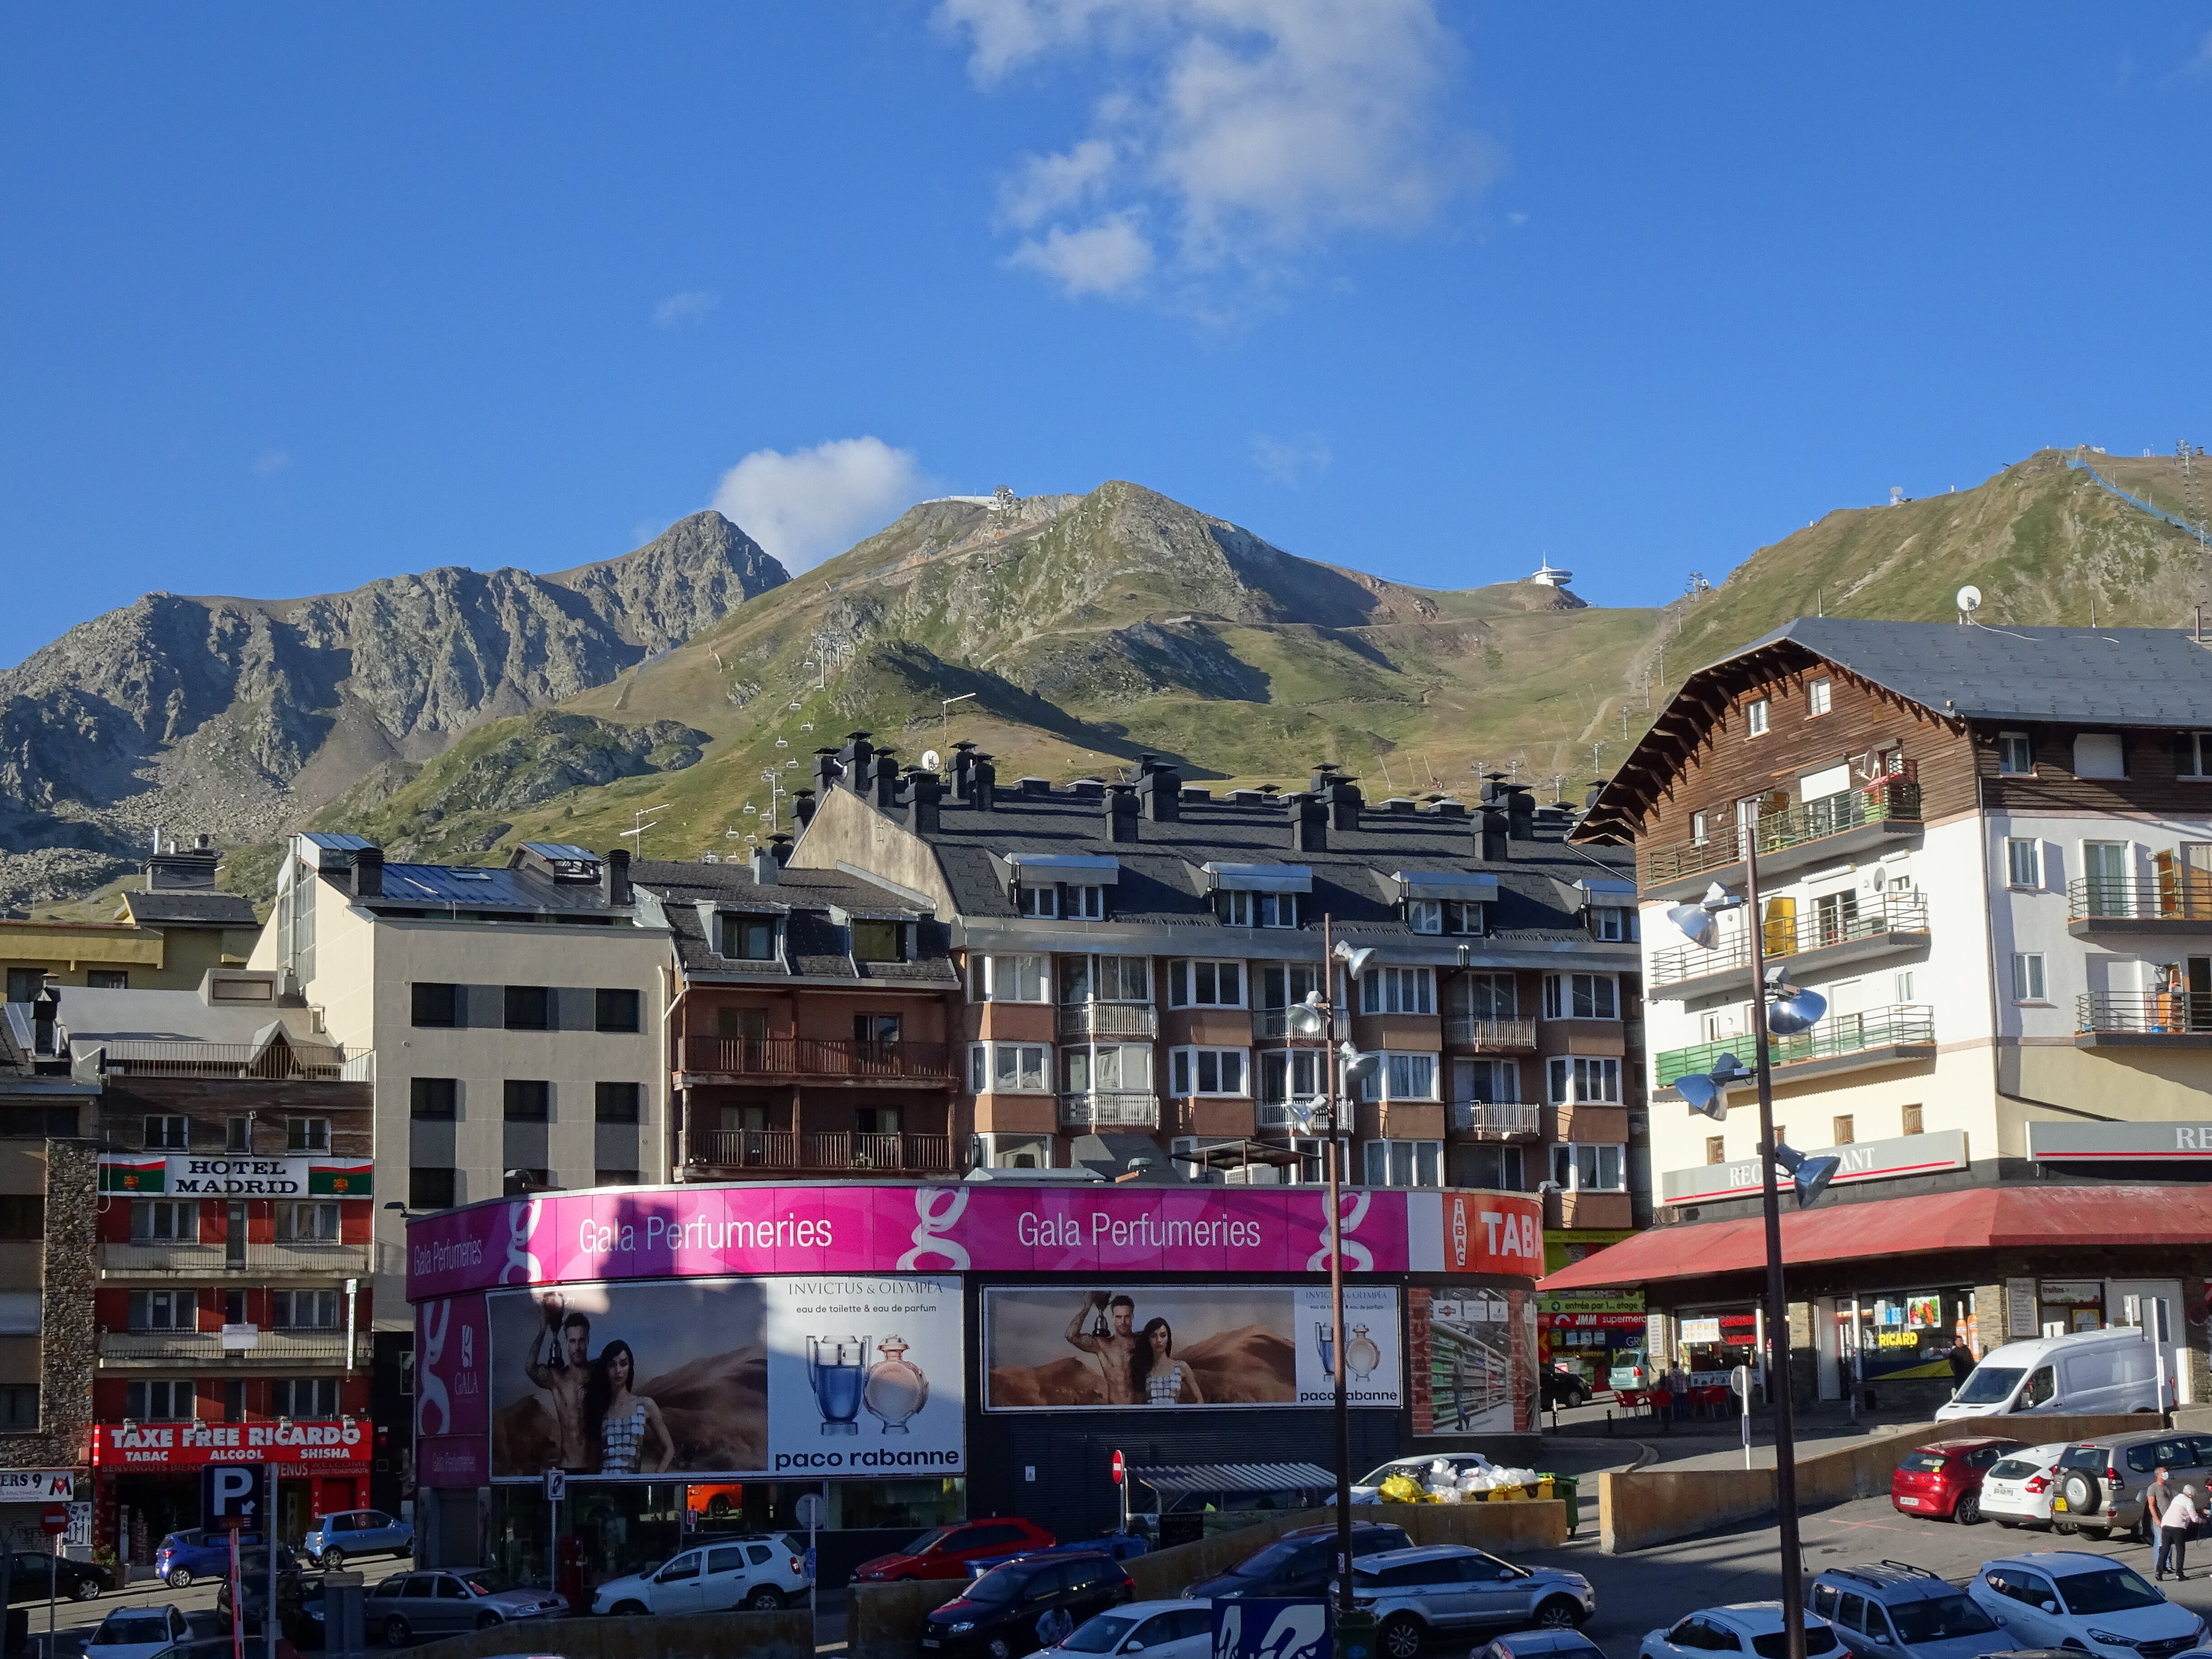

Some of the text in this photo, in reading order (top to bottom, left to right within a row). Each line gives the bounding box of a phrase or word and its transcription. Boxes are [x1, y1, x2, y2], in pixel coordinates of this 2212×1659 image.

[188, 1161, 286, 1175] HOTEL
[176, 1179, 298, 1194] MADRID
[580, 1213, 832, 1253] Gala Perfumeries
[1018, 1212, 1261, 1247] Gala Perfumeries
[1455, 1201, 1465, 1262] TABAC
[414, 1234, 482, 1277] Gala Perfumeries
[789, 1282, 862, 1295] INVICTUS
[867, 1285, 875, 1294] &
[815, 1304, 827, 1313] de
[829, 1304, 862, 1313] toilette
[864, 1304, 870, 1312] &
[891, 1303, 902, 1312] de
[904, 1303, 937, 1314] parfum
[1565, 1301, 1589, 1309] entrée
[1591, 1303, 1604, 1311] par
[1617, 1301, 1638, 1311] étage
[1575, 1314, 1597, 1325] JMM
[1878, 1332, 1918, 1346] RICARD
[455, 1373, 478, 1395] GALA
[1300, 1390, 1398, 1402] paco abanne
[111, 1426, 361, 1448] TAXE FREE RICARDO
[125, 1448, 351, 1462] TABAC ALCOOL SHISHA
[775, 1448, 959, 1471] paco rabanne
[102, 1464, 167, 1472] BENVINGUTS
[32, 1473, 42, 1488] 9
[214, 1468, 253, 1515] P
